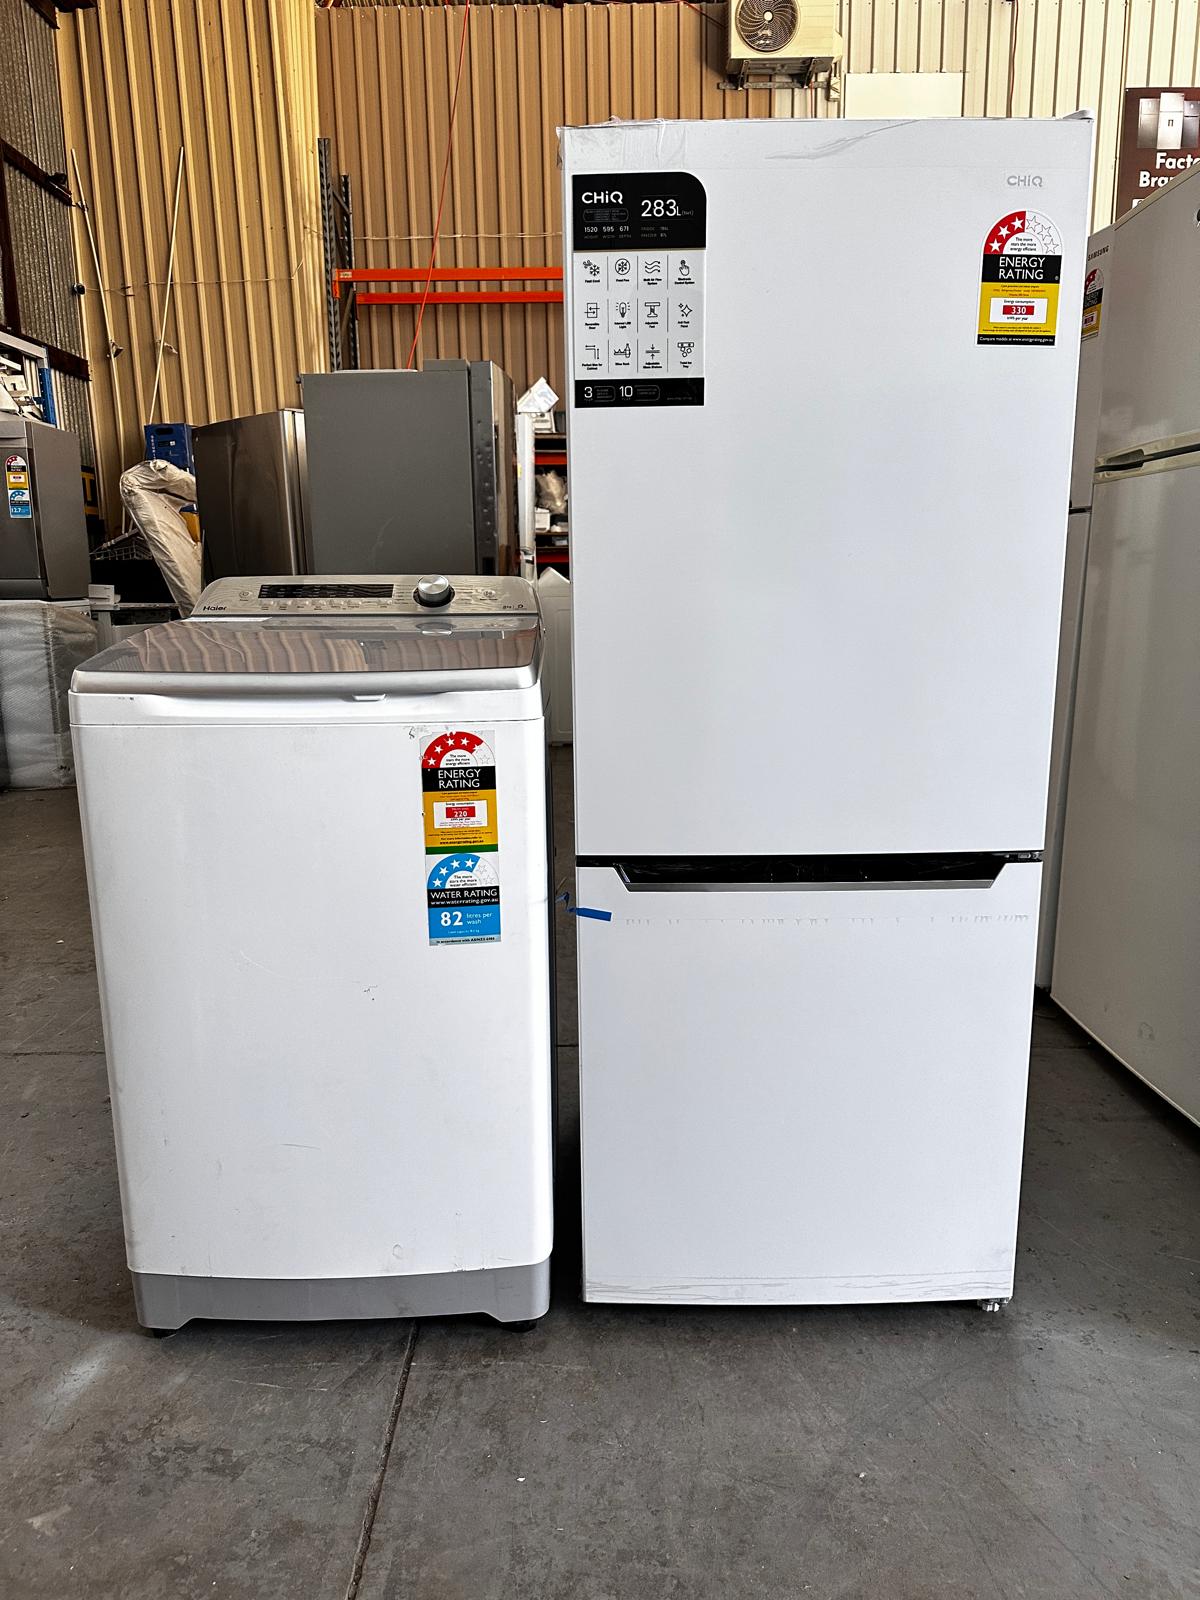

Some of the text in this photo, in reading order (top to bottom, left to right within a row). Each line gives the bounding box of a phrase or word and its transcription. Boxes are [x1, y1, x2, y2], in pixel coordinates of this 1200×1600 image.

[1139, 170, 1175, 188] Bra
[1087, 245, 1110, 262] SAMSUNG
[999, 256, 1046, 268] ENERGY
[998, 268, 1044, 280] RATING
[1011, 306, 1027, 314] 330
[584, 386, 593, 398] 3
[619, 385, 633, 398] 10
[438, 768, 481, 779] ENERGY
[438, 778, 480, 789] RATING
[430, 888, 498, 899] WATER RATING
[440, 910, 463, 926] 82
